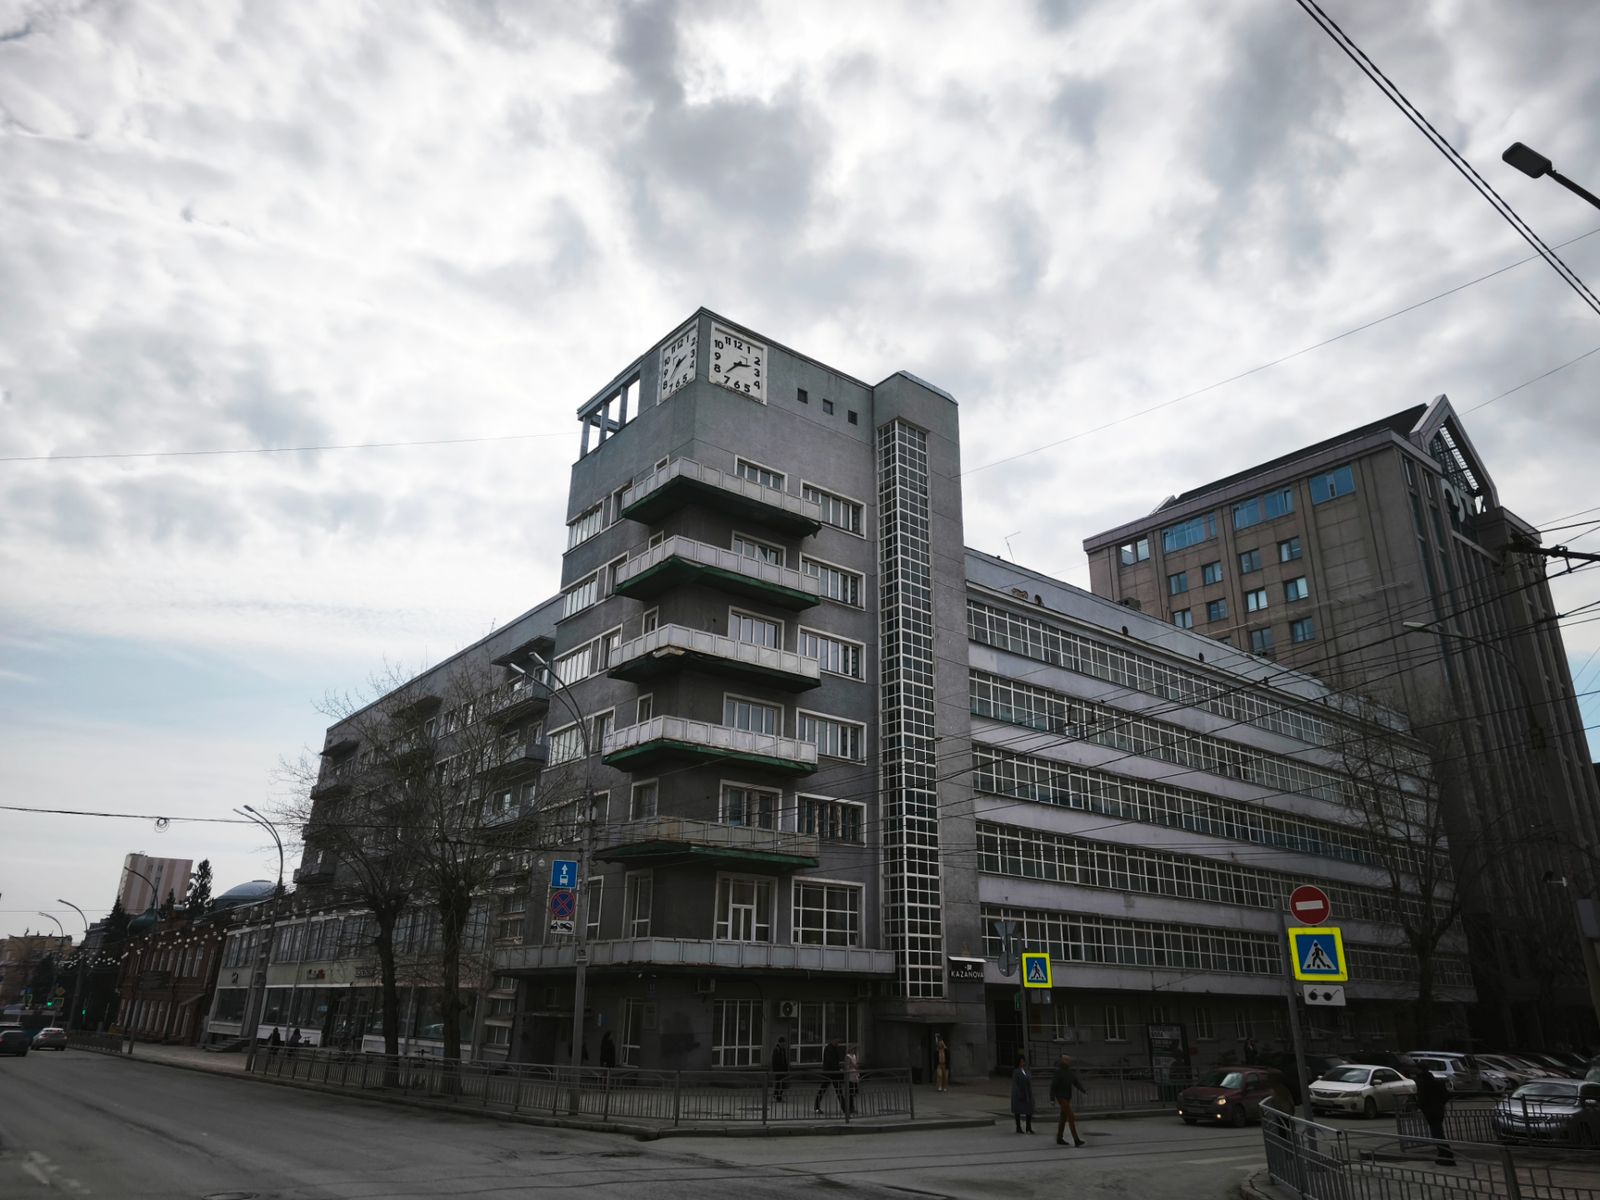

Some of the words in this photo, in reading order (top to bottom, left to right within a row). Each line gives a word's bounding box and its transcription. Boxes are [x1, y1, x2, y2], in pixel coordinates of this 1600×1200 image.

[677, 340, 683, 349] 12
[691, 338, 696, 346] 2
[714, 340, 723, 349] 10
[725, 337, 731, 345] 11
[734, 340, 742, 350] 12
[691, 349, 695, 358] 3
[664, 357, 670, 366] 10
[690, 360, 694, 368] 4
[754, 357, 760, 366] 2
[714, 364, 721, 372] 8
[663, 369, 668, 378] 9
[754, 369, 760, 377] 3
[682, 374, 688, 382] 5
[663, 382, 667, 390] 8
[676, 379, 680, 387] 6
[754, 381, 760, 390] 4
[669, 384, 673, 393] 7
[744, 384, 750, 393] 5
